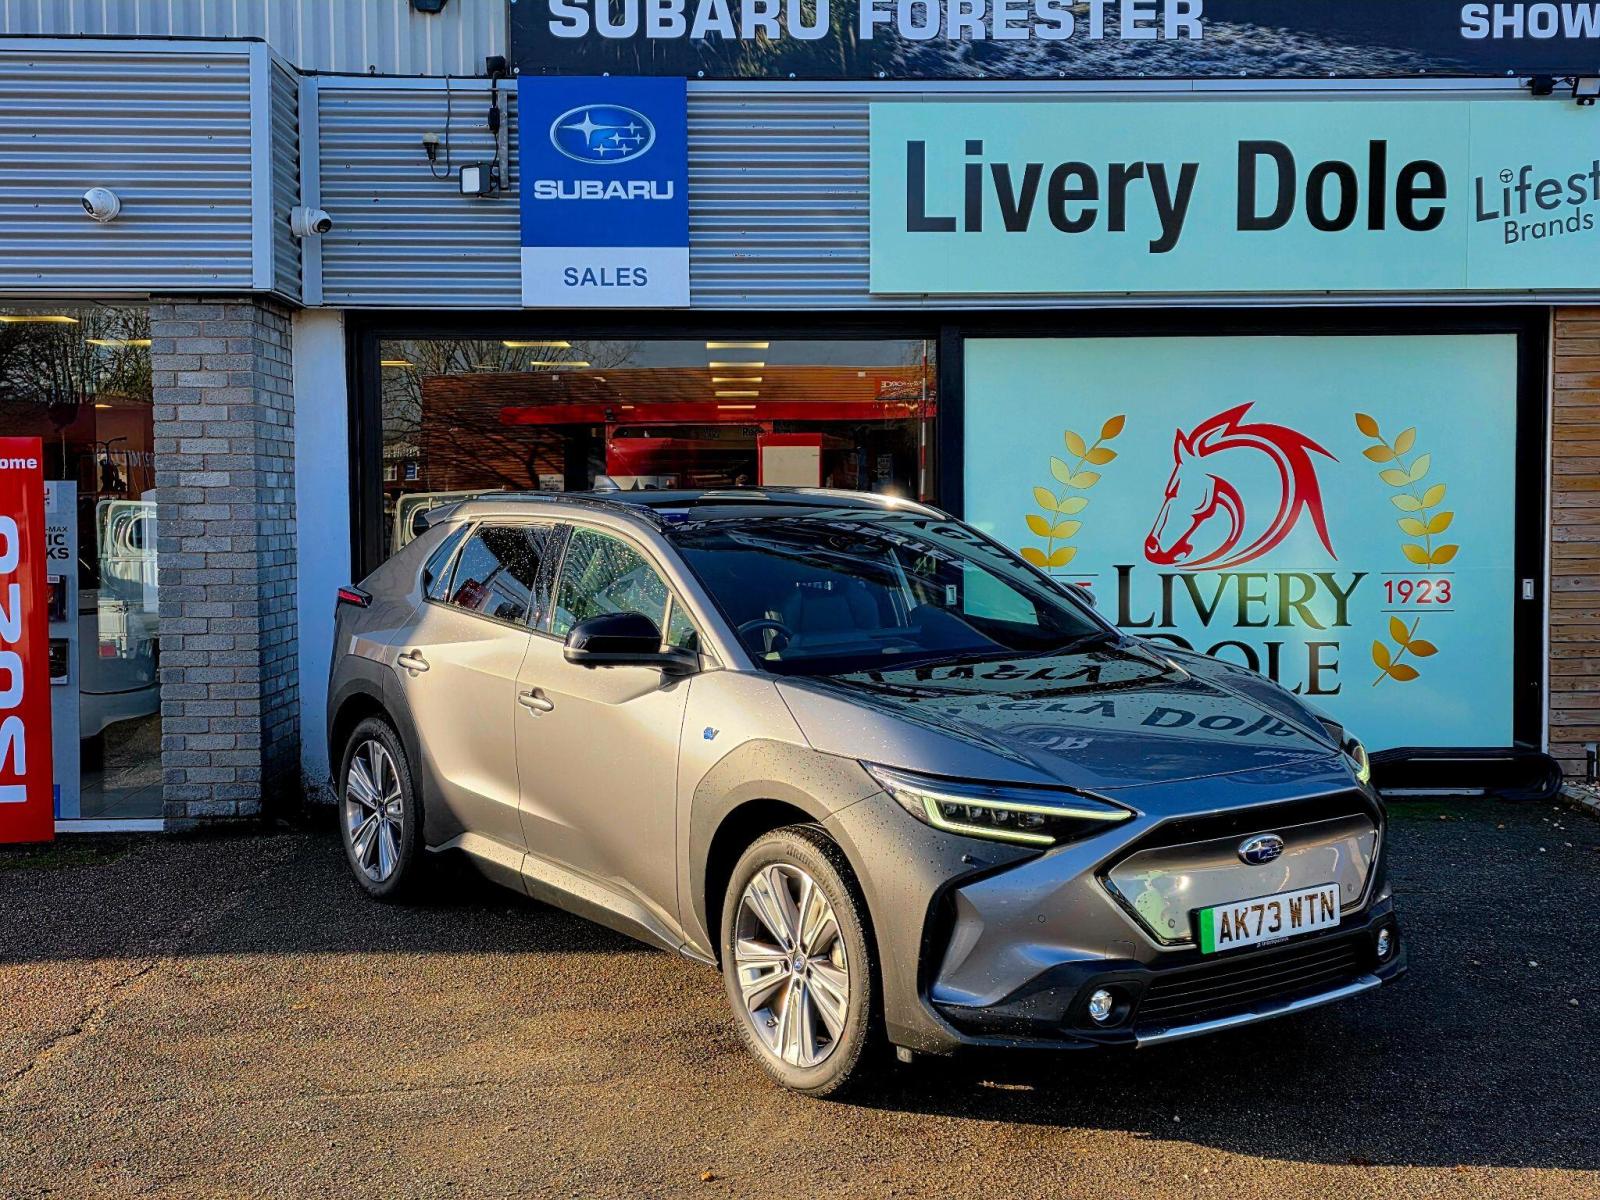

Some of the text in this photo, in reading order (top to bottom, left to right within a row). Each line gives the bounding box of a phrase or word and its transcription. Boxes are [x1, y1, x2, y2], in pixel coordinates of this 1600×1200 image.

[549, 0, 1204, 40] SUBARU FORESTER
[534, 179, 674, 200] SUBARU
[906, 139, 1447, 253] Livery Dole
[1505, 207, 1594, 245] Brands
[564, 266, 648, 287] SALES
[1112, 564, 1369, 630] LIVERY
[1384, 579, 1452, 604] 1923
[1134, 632, 1342, 696] OLE
[1219, 890, 1335, 944] AK73 WTN
